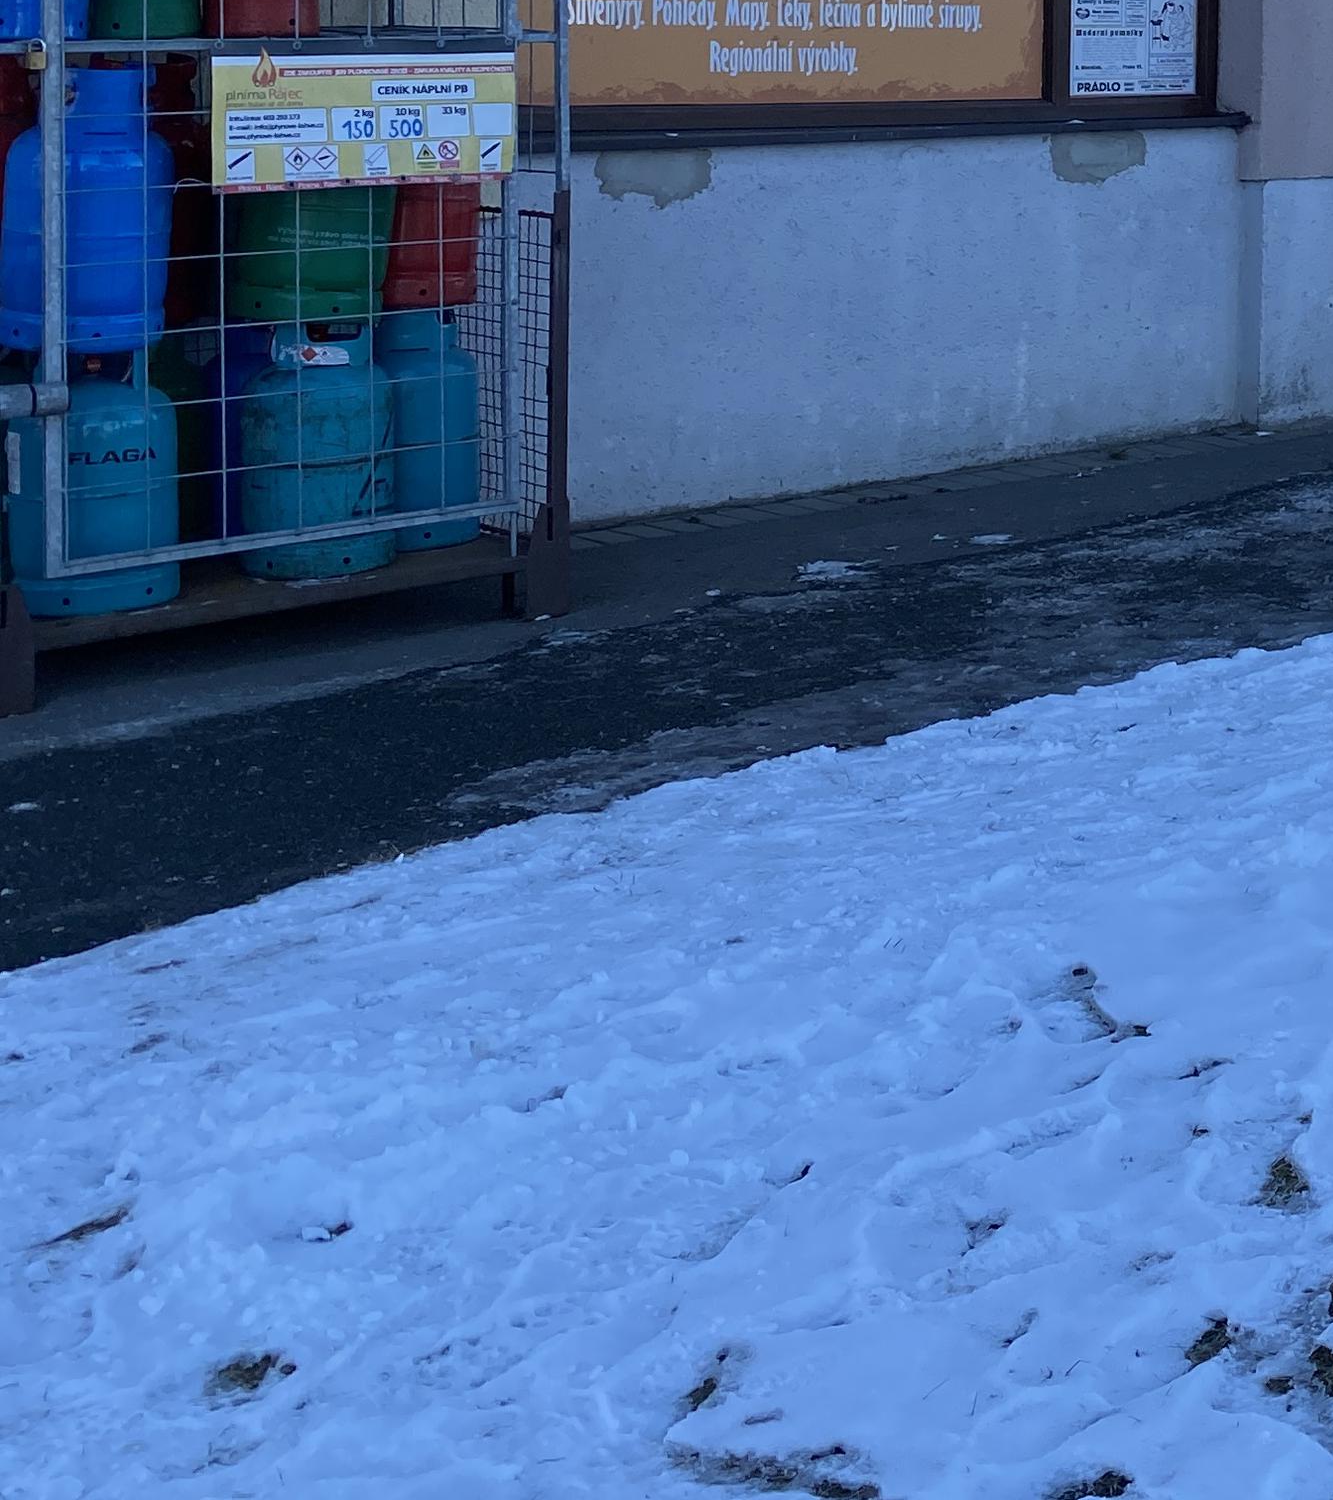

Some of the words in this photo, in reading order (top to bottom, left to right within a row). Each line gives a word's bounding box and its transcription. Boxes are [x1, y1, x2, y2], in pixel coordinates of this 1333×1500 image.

[867, 2, 876, 28] a
[709, 39, 794, 76] Regionální
[798, 40, 858, 76] výrobky.
[268, 87, 303, 102] Rájec
[377, 83, 410, 96] CENÍK
[412, 82, 451, 95] NÁPLNÍ
[454, 84, 469, 94] PB
[354, 109, 360, 118] 2
[361, 108, 375, 119] kg
[395, 108, 407, 117] 10
[408, 108, 421, 118] kg
[454, 106, 467, 117] kg
[342, 119, 374, 140] 150
[388, 118, 424, 139] 500
[68, 446, 157, 466] FLAGA
